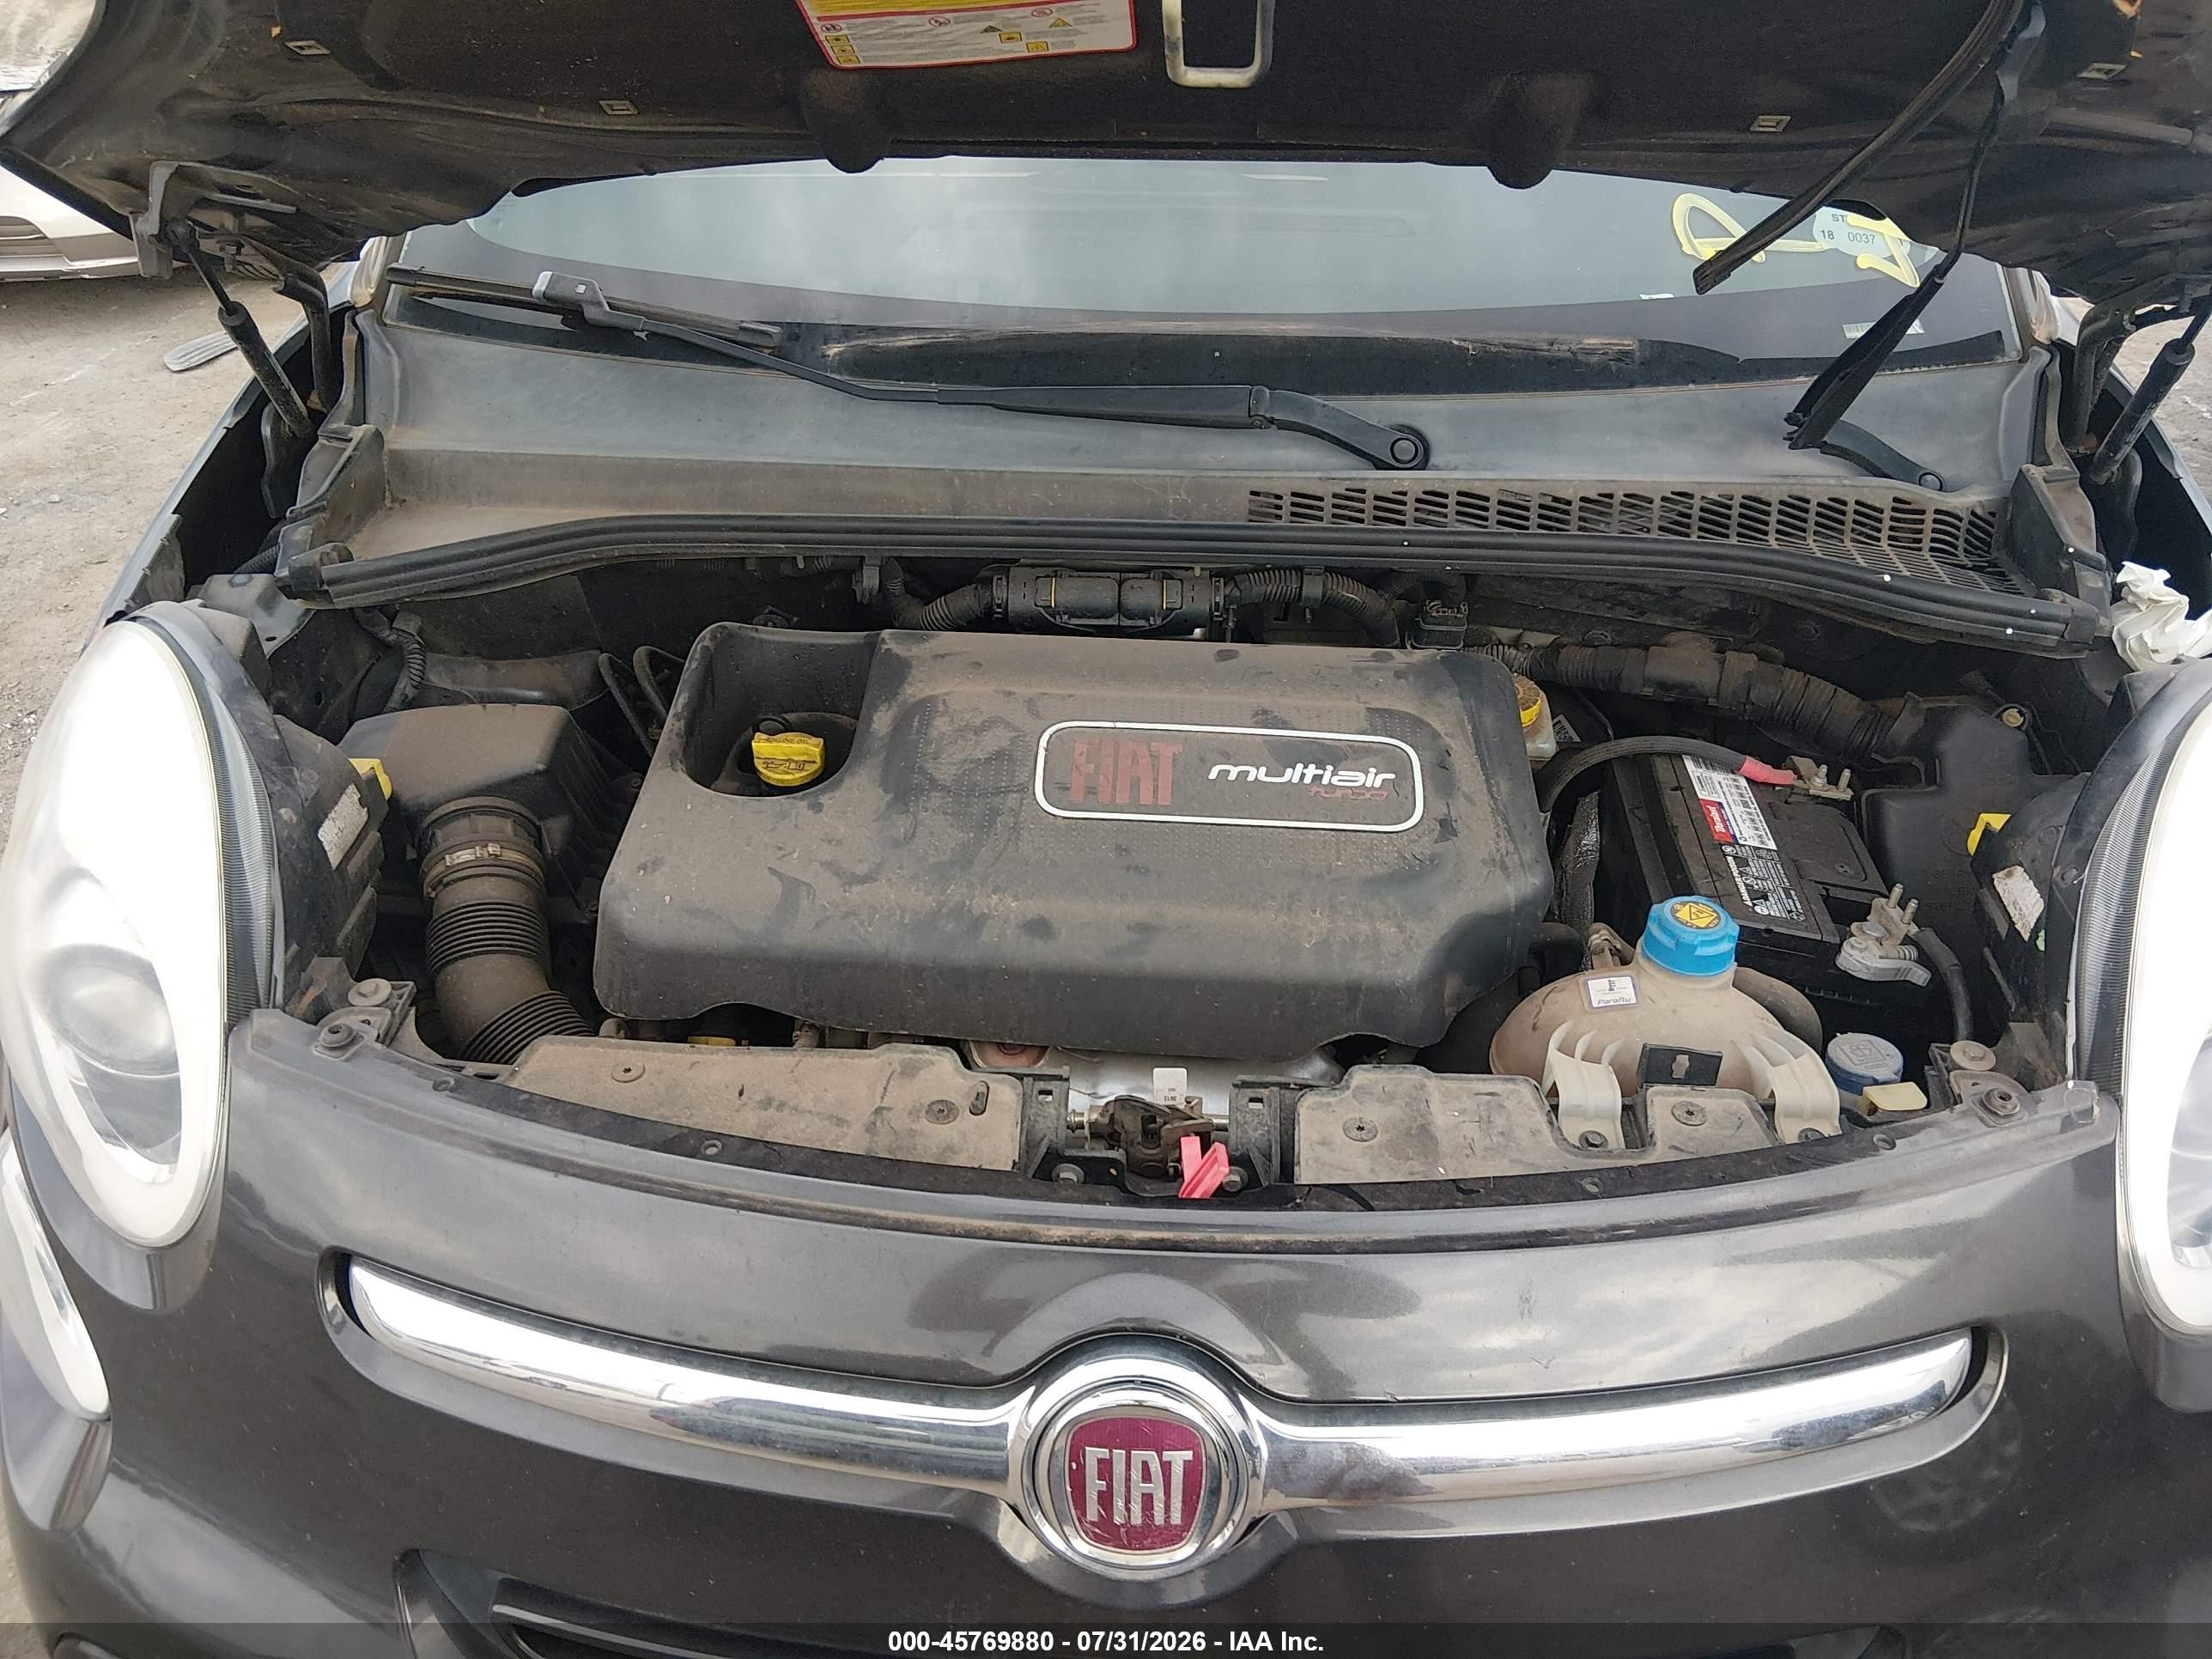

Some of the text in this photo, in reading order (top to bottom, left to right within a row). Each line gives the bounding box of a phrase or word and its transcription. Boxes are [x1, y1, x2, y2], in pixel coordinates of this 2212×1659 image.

[1820, 229, 1835, 240] 18
[1068, 738, 1183, 806] FIAT
[1207, 762, 1397, 788] multiair
[1307, 786, 1390, 801] turbo
[1085, 1446, 1194, 1526] FIAT
